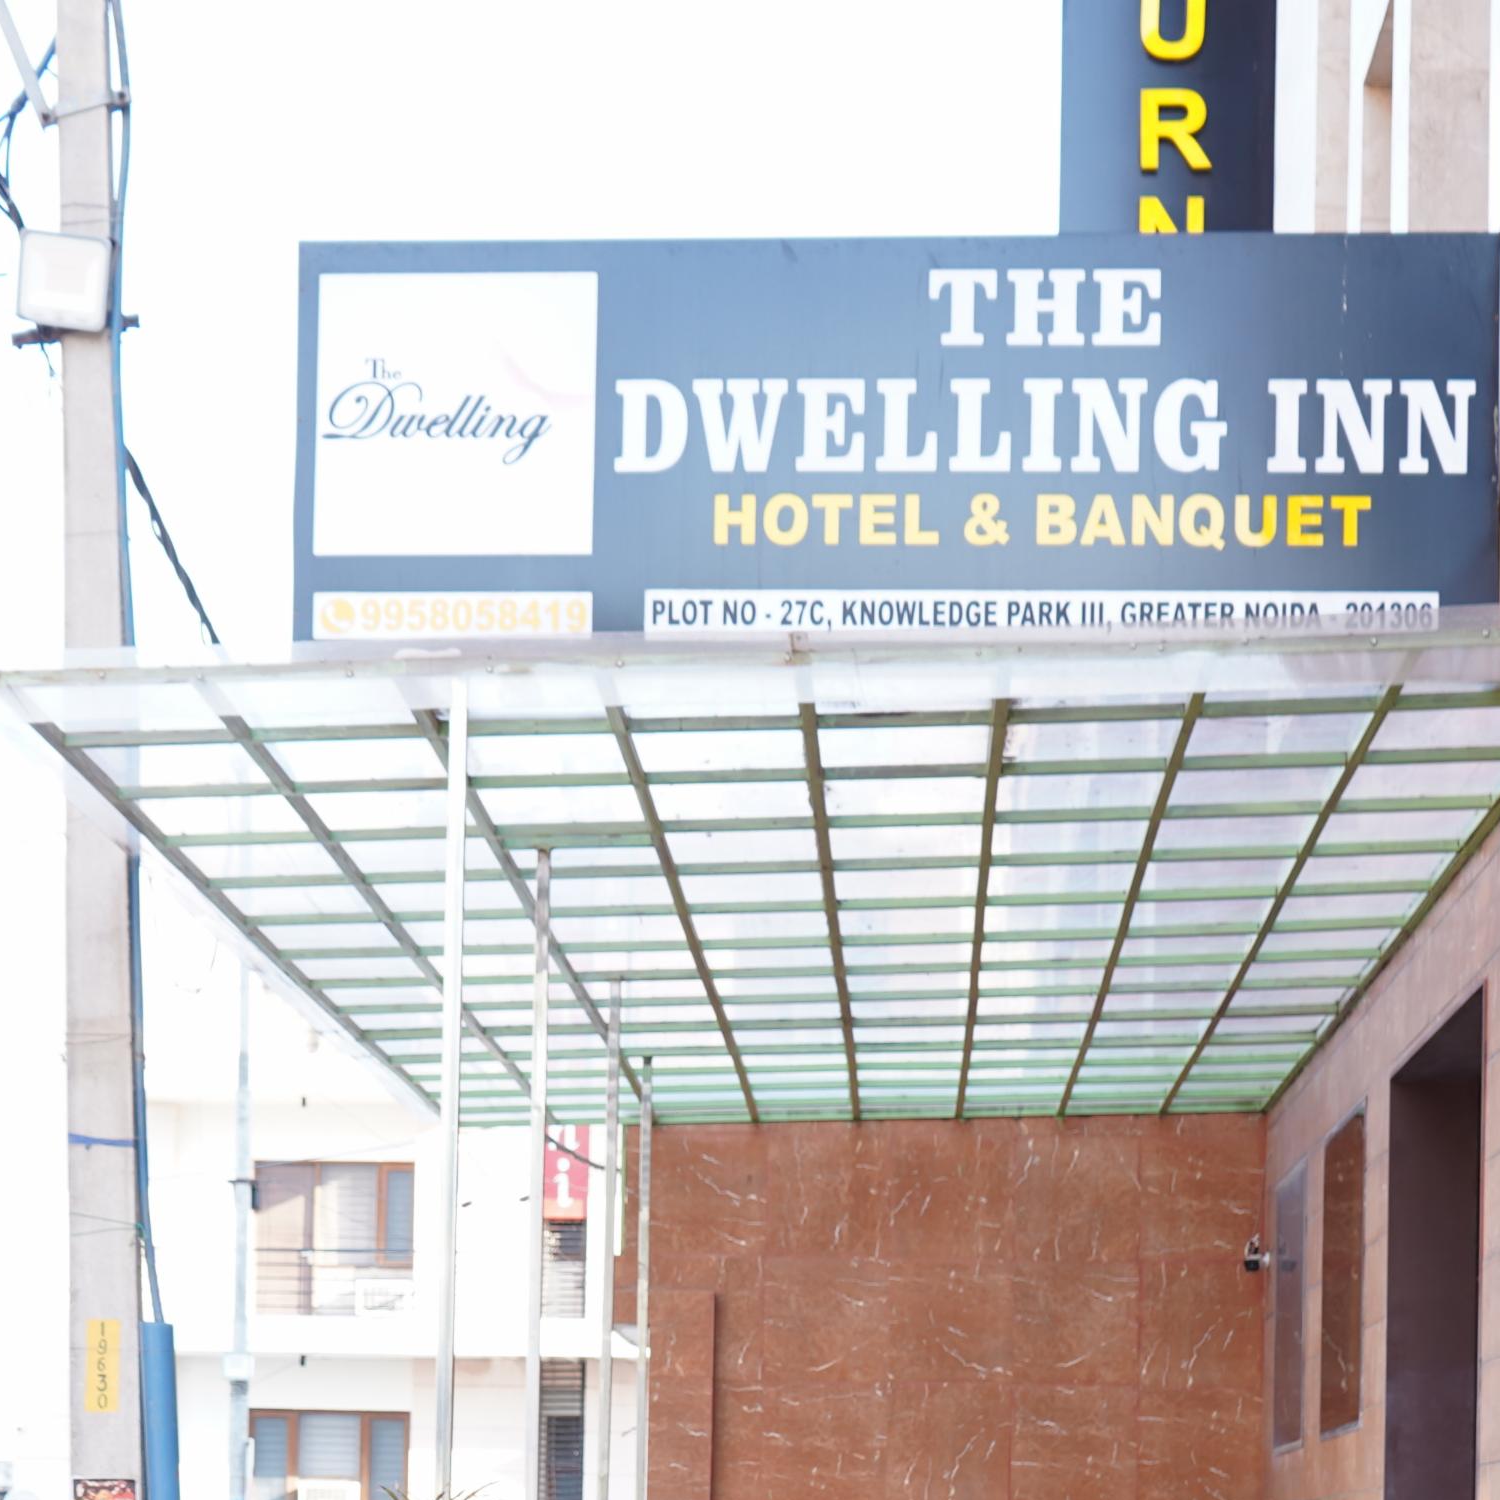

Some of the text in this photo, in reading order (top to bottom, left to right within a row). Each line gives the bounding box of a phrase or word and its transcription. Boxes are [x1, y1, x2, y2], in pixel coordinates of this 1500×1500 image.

[928, 268, 1162, 347] THE
[364, 357, 402, 381] The
[321, 381, 552, 465] Dwelling
[614, 378, 1228, 474] DWELLING
[1266, 378, 1476, 475] INN
[713, 492, 1373, 552] HOTEL & BANQUET
[361, 598, 588, 635] 9958058419
[652, 600, 714, 626] PLOT
[722, 600, 757, 626] NO
[781, 600, 832, 632] 27C,
[842, 600, 998, 628] KNOWLEDGE
[1007, 601, 1070, 628] PARK
[1081, 601, 1113, 633] III,
[1121, 601, 1235, 628] GREATER
[1245, 602, 1323, 629] NOIDA
[1345, 602, 1433, 630] 201306
